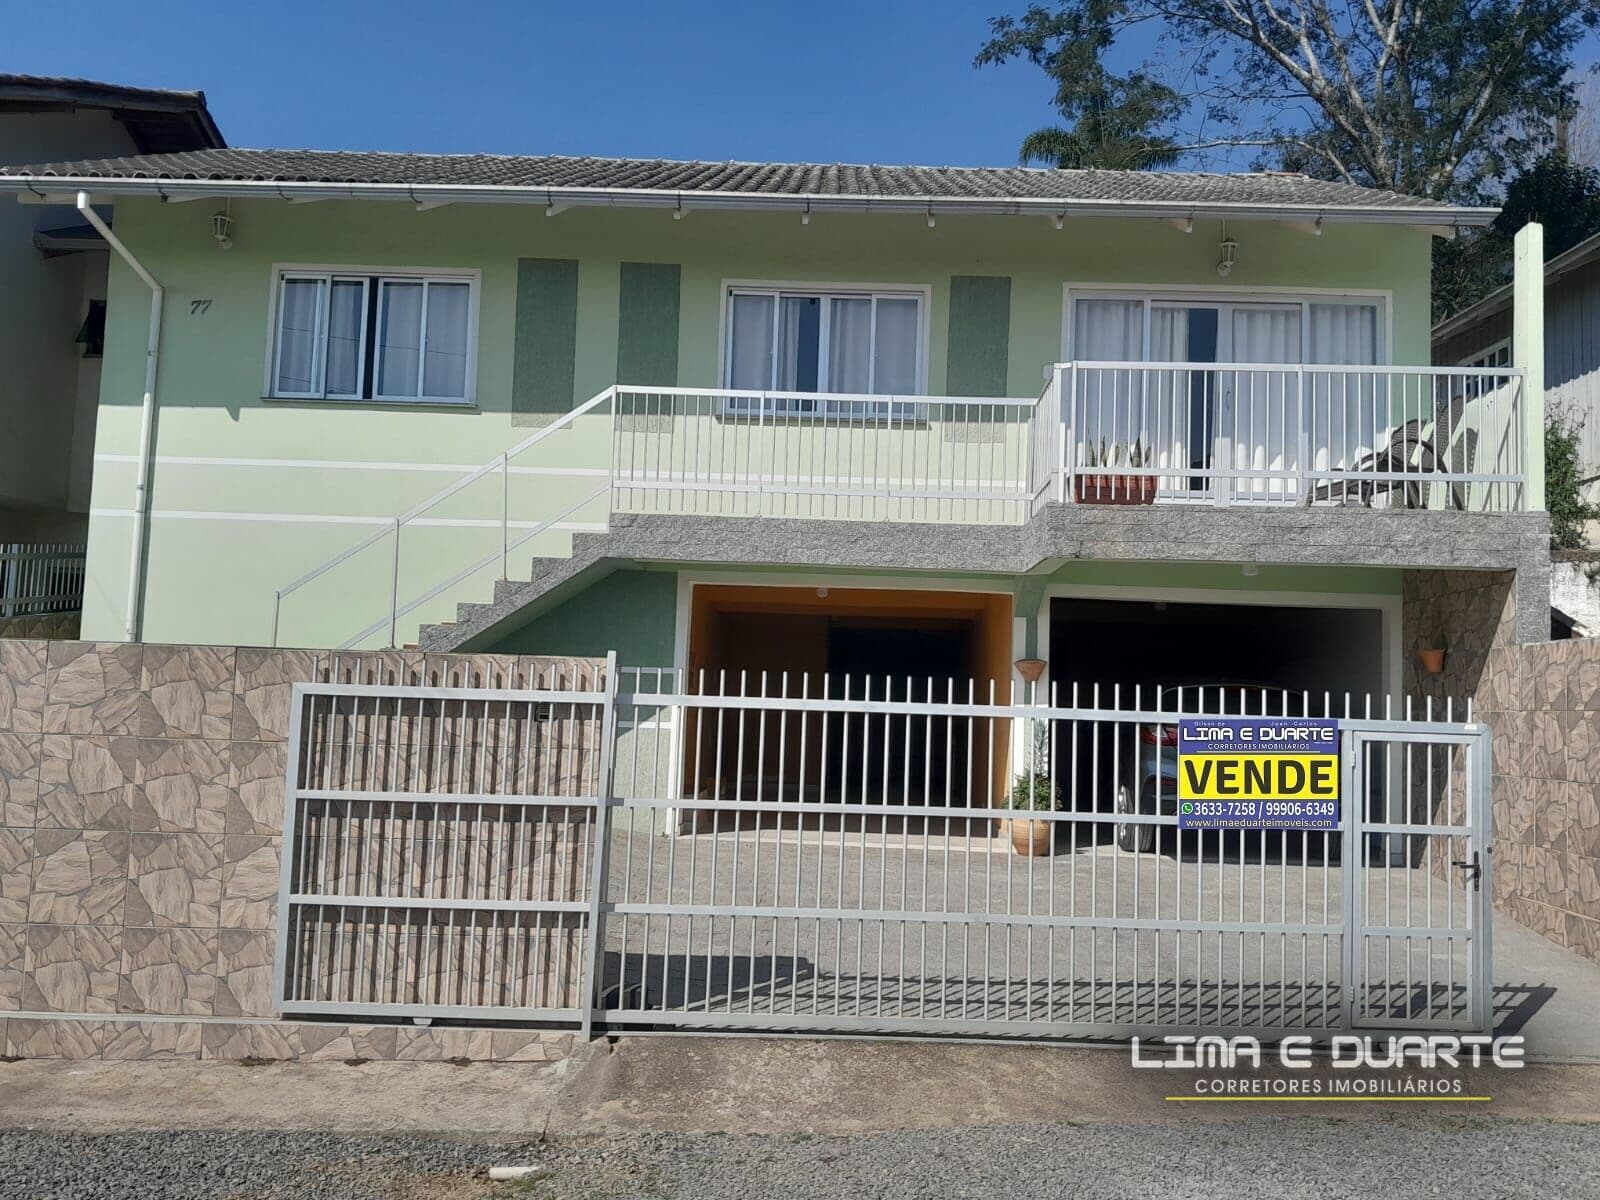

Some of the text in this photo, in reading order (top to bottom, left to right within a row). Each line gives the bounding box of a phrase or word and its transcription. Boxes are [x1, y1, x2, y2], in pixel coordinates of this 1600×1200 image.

[191, 299, 213, 315] 77
[1183, 727, 1334, 741] LIMA E DUARTE
[1184, 760, 1333, 794] VENDE
[1194, 802, 1256, 816] 3633-7258
[1266, 802, 1335, 816] 99906-6349
[1185, 818, 1332, 827] www.limaeduarteimoveis.com
